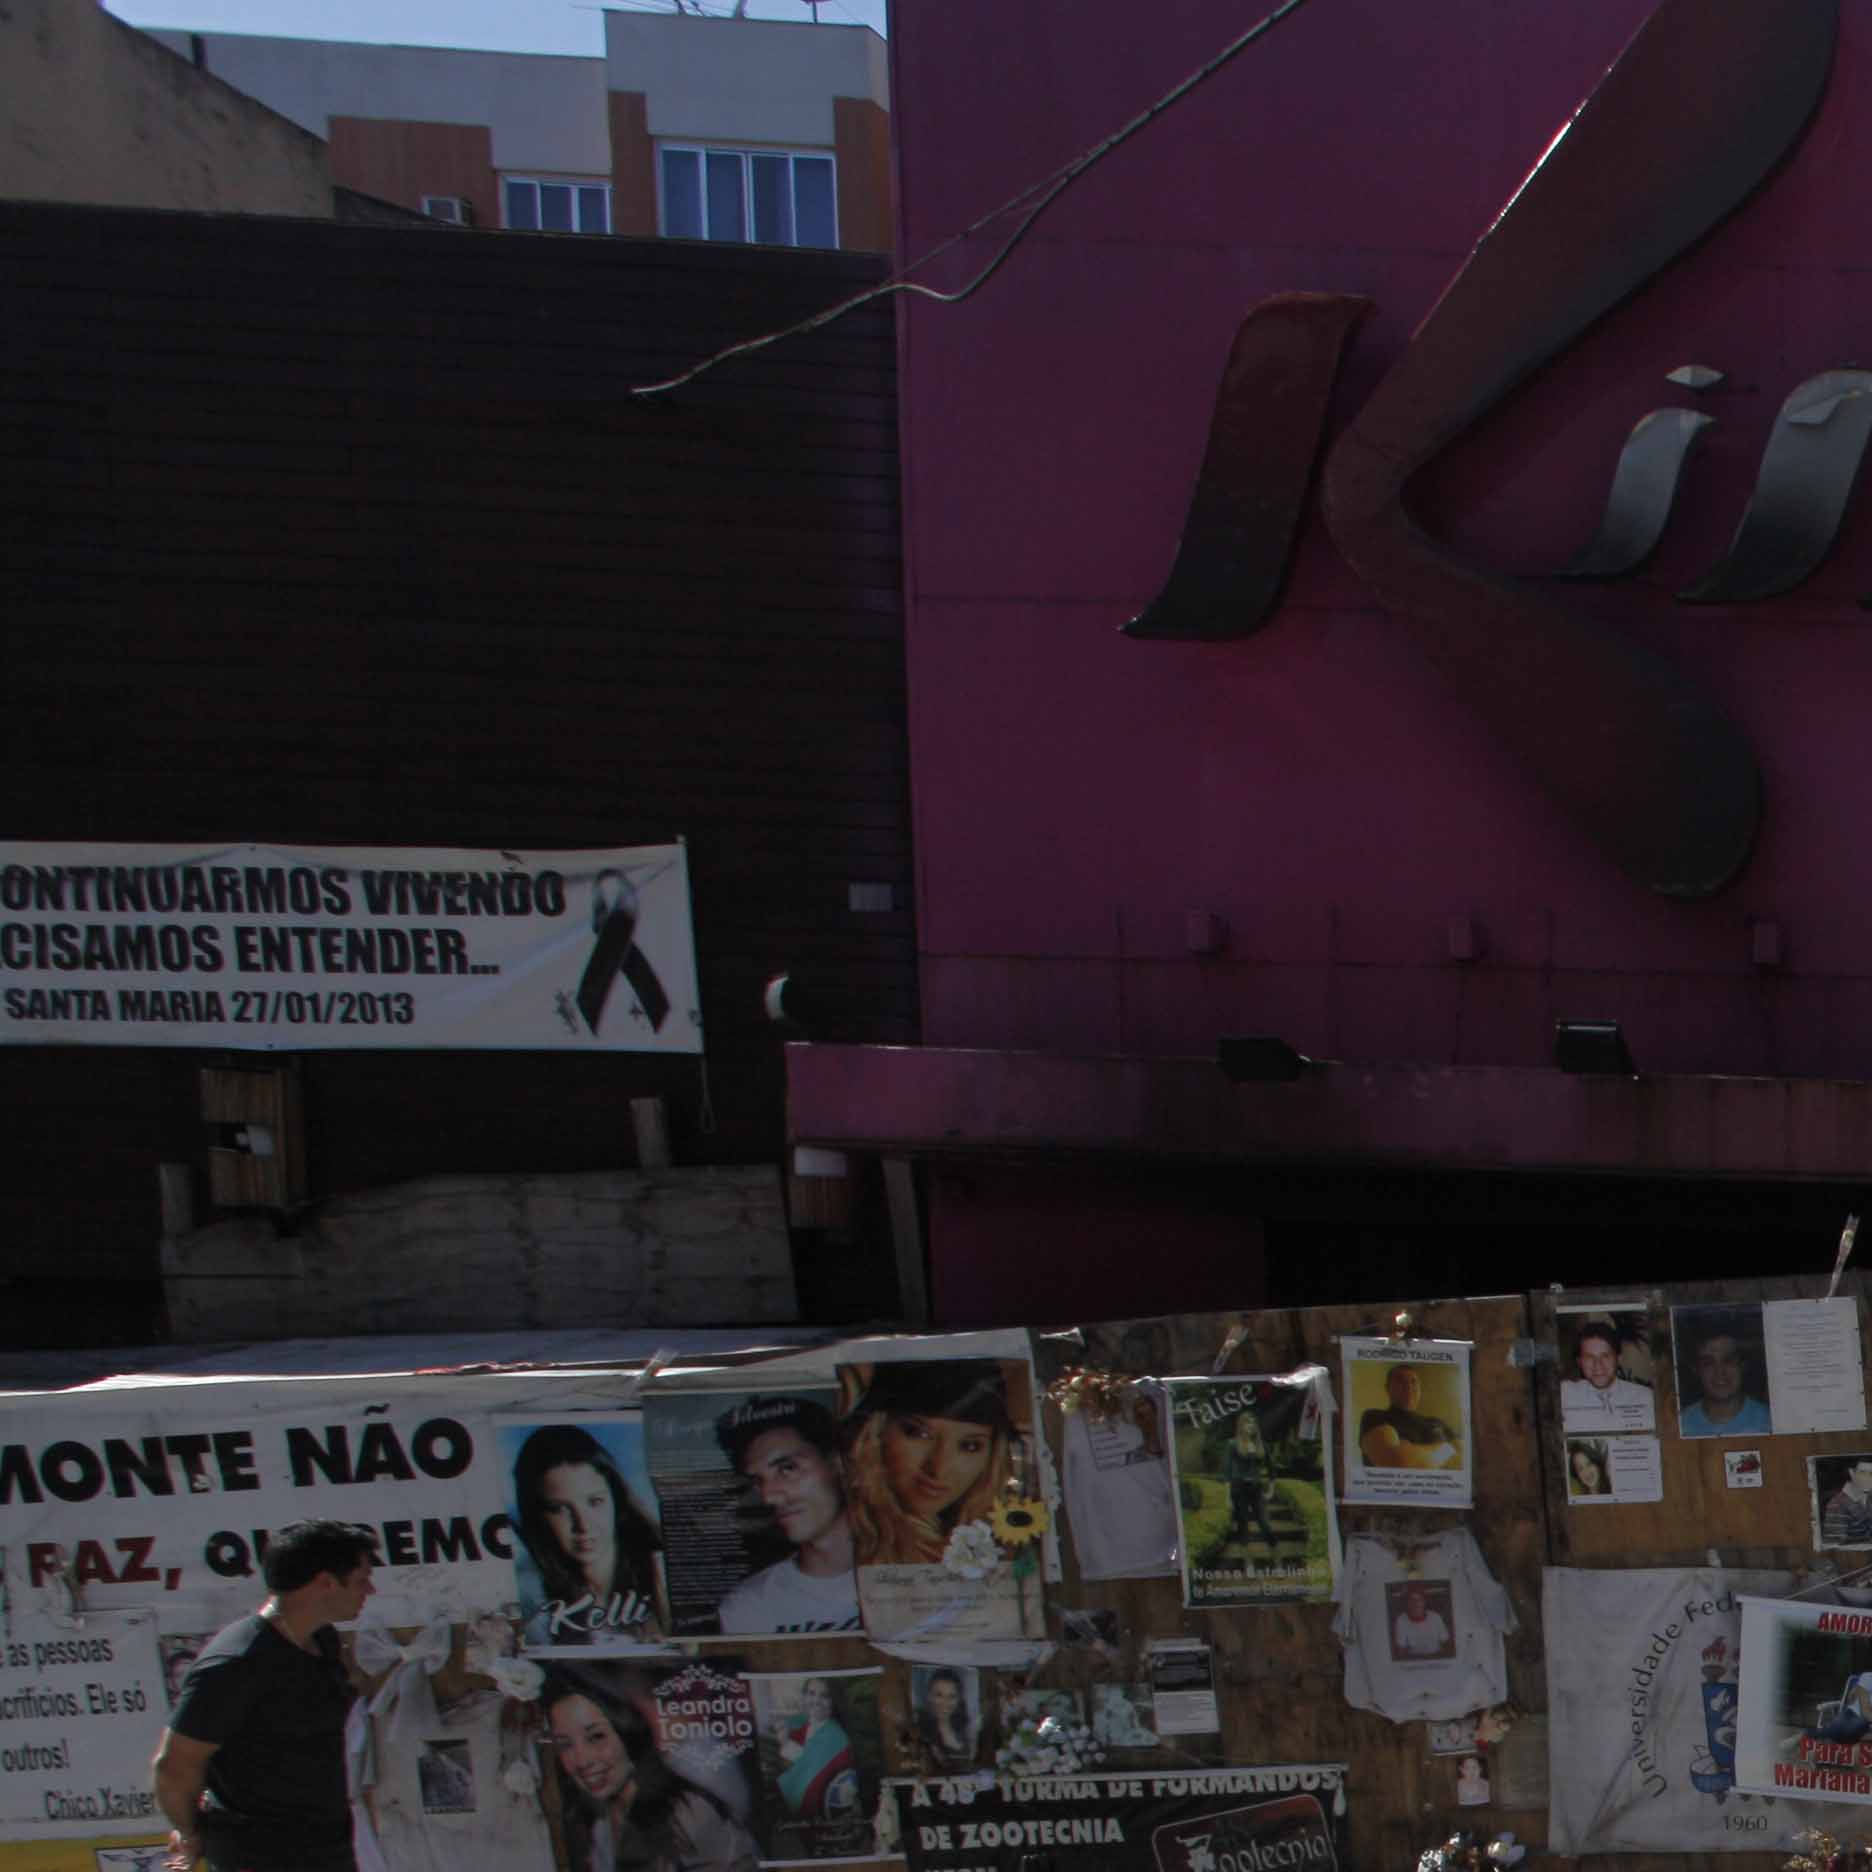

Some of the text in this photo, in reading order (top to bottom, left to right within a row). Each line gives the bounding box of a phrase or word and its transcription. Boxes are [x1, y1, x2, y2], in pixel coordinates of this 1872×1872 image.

[1, 864, 566, 917] ONTINUARMOS VIVENDO
[1, 922, 499, 976] CISAMOS ENTENDER...
[5, 987, 416, 1025] SANTA MARIA 27/01/2013
[0, 1404, 474, 1502] MONTE NÃO
[28, 1535, 182, 1591] PAZ,
[543, 1595, 653, 1635] Kelli
[1819, 1611, 1872, 1635] AMOR
[8, 1638, 113, 1672] as pessoas
[86, 1680, 146, 1715] Ele só
[656, 1695, 751, 1717] Leandra
[1628, 1623, 1682, 1798] Universidade
[659, 1715, 753, 1741] Toniolo
[1800, 1734, 1855, 1766] Para
[1775, 1763, 1870, 1796] Mariana
[46, 1789, 98, 1820] Chico
[919, 1817, 1126, 1851] DE ZOOTECNIA
[1723, 1814, 1768, 1832] 1960
